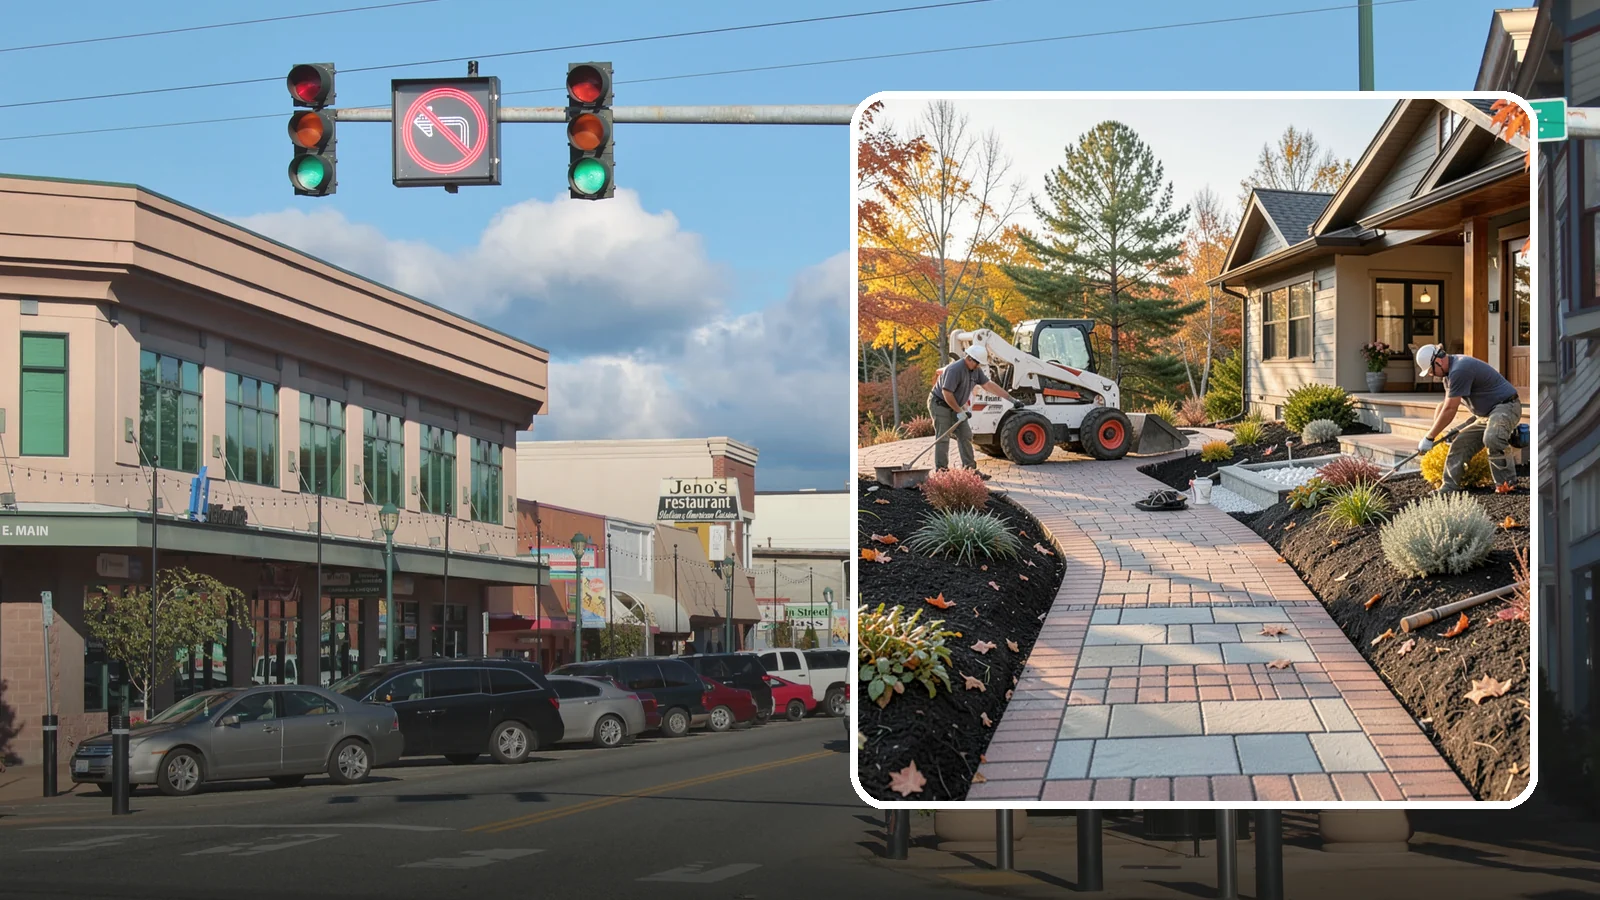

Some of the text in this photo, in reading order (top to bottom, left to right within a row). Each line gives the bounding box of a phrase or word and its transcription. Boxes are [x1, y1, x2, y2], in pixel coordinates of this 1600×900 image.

[669, 480, 727, 494] Jeno's
[665, 496, 730, 508] restaurant
[658, 509, 681, 519] Italian
[686, 509, 715, 519] American
[715, 509, 737, 519] Cuisine
[2, 525, 49, 536] E. MAIN
[797, 607, 828, 617] Street
